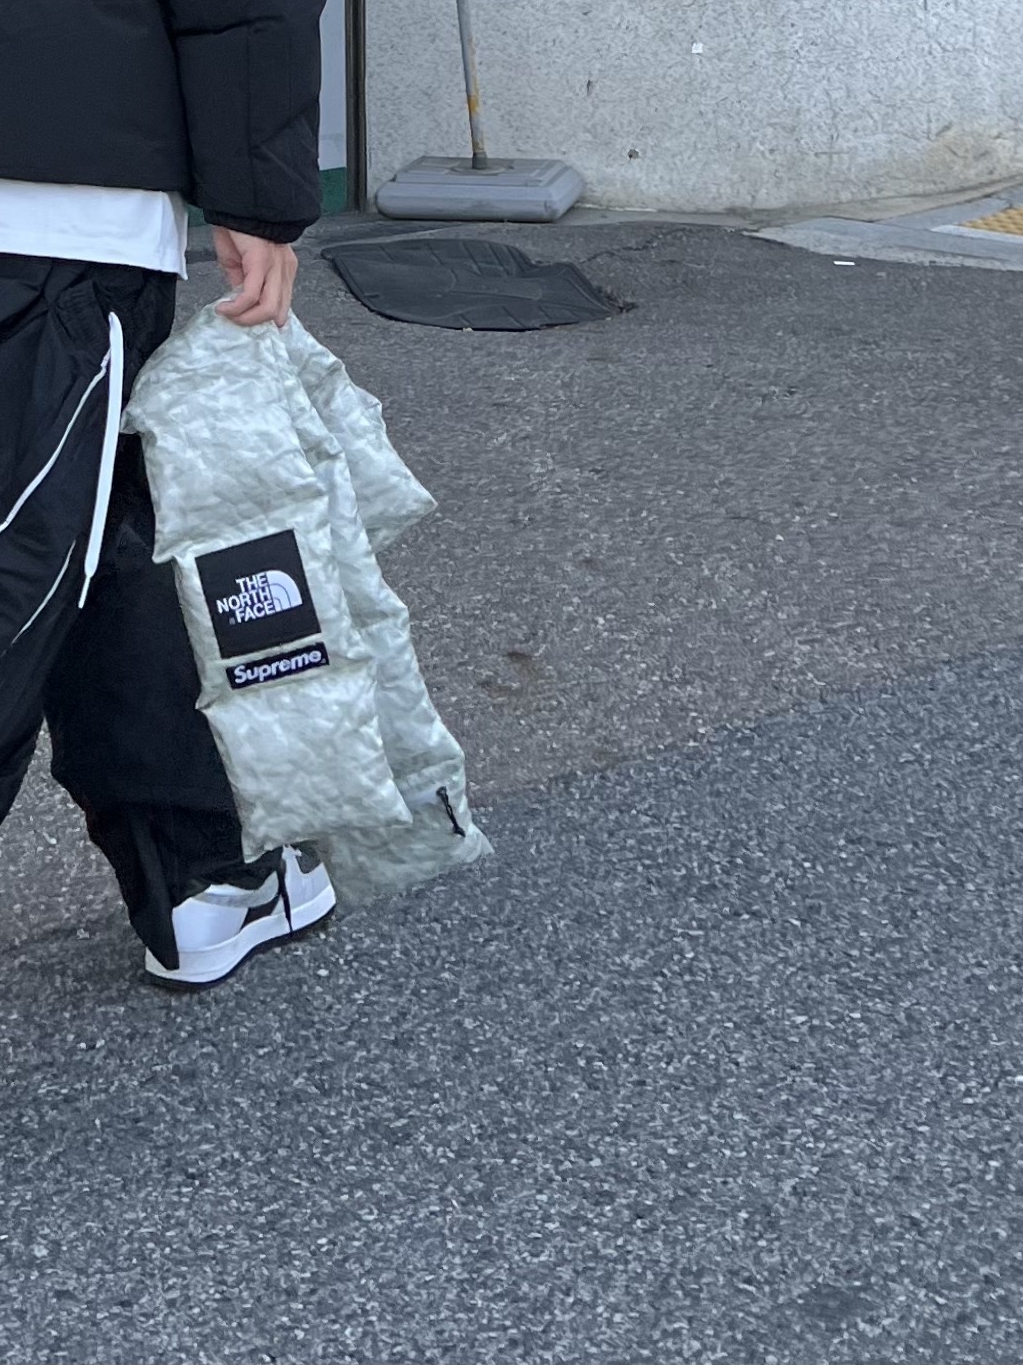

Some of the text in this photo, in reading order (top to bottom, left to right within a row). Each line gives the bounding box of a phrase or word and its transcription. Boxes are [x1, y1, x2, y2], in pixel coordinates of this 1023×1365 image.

[236, 573, 268, 592] THE
[216, 588, 271, 614] NORTH
[235, 603, 276, 624] FACE
[234, 649, 322, 683] Supreme
